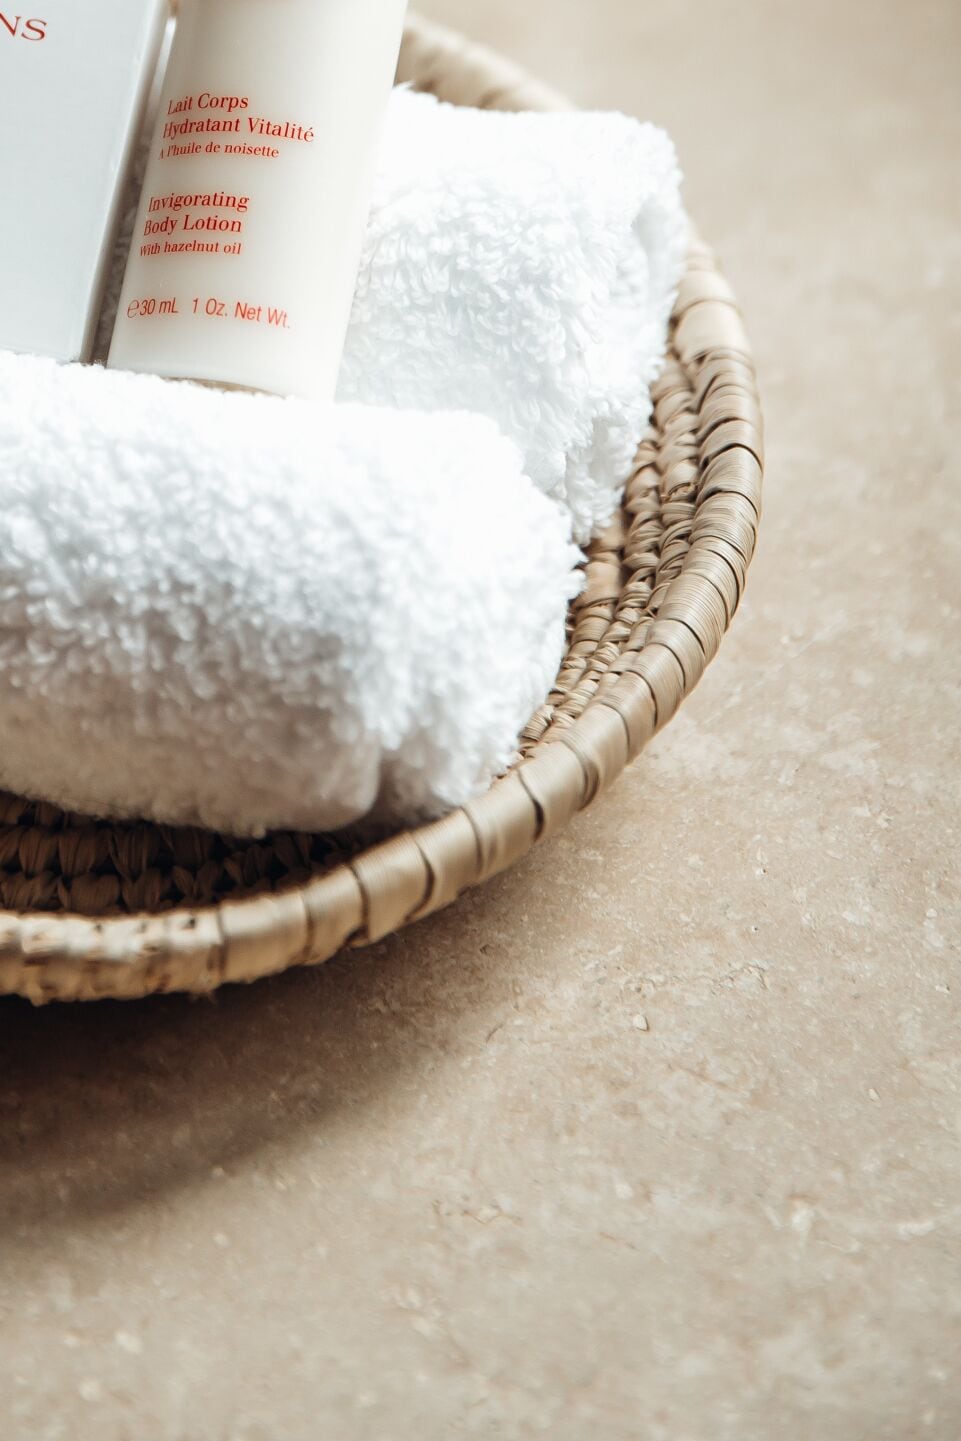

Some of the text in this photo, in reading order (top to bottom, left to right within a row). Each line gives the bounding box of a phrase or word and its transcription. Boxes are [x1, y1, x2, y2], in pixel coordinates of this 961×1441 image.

[167, 93, 249, 115] Lait Corps
[162, 117, 315, 143] Hydratant Vitalité
[167, 142, 202, 157] l'huile
[205, 141, 221, 153] de
[224, 143, 279, 158] noisette
[148, 191, 250, 213] Invigorating
[143, 214, 242, 236] Body Lotion
[140, 240, 242, 257] With hazelnut oil
[159, 297, 179, 313] mL
[192, 298, 199, 314] 1
[205, 298, 228, 317] Oz.
[234, 301, 262, 322] Net
[267, 306, 291, 329] Wt.
